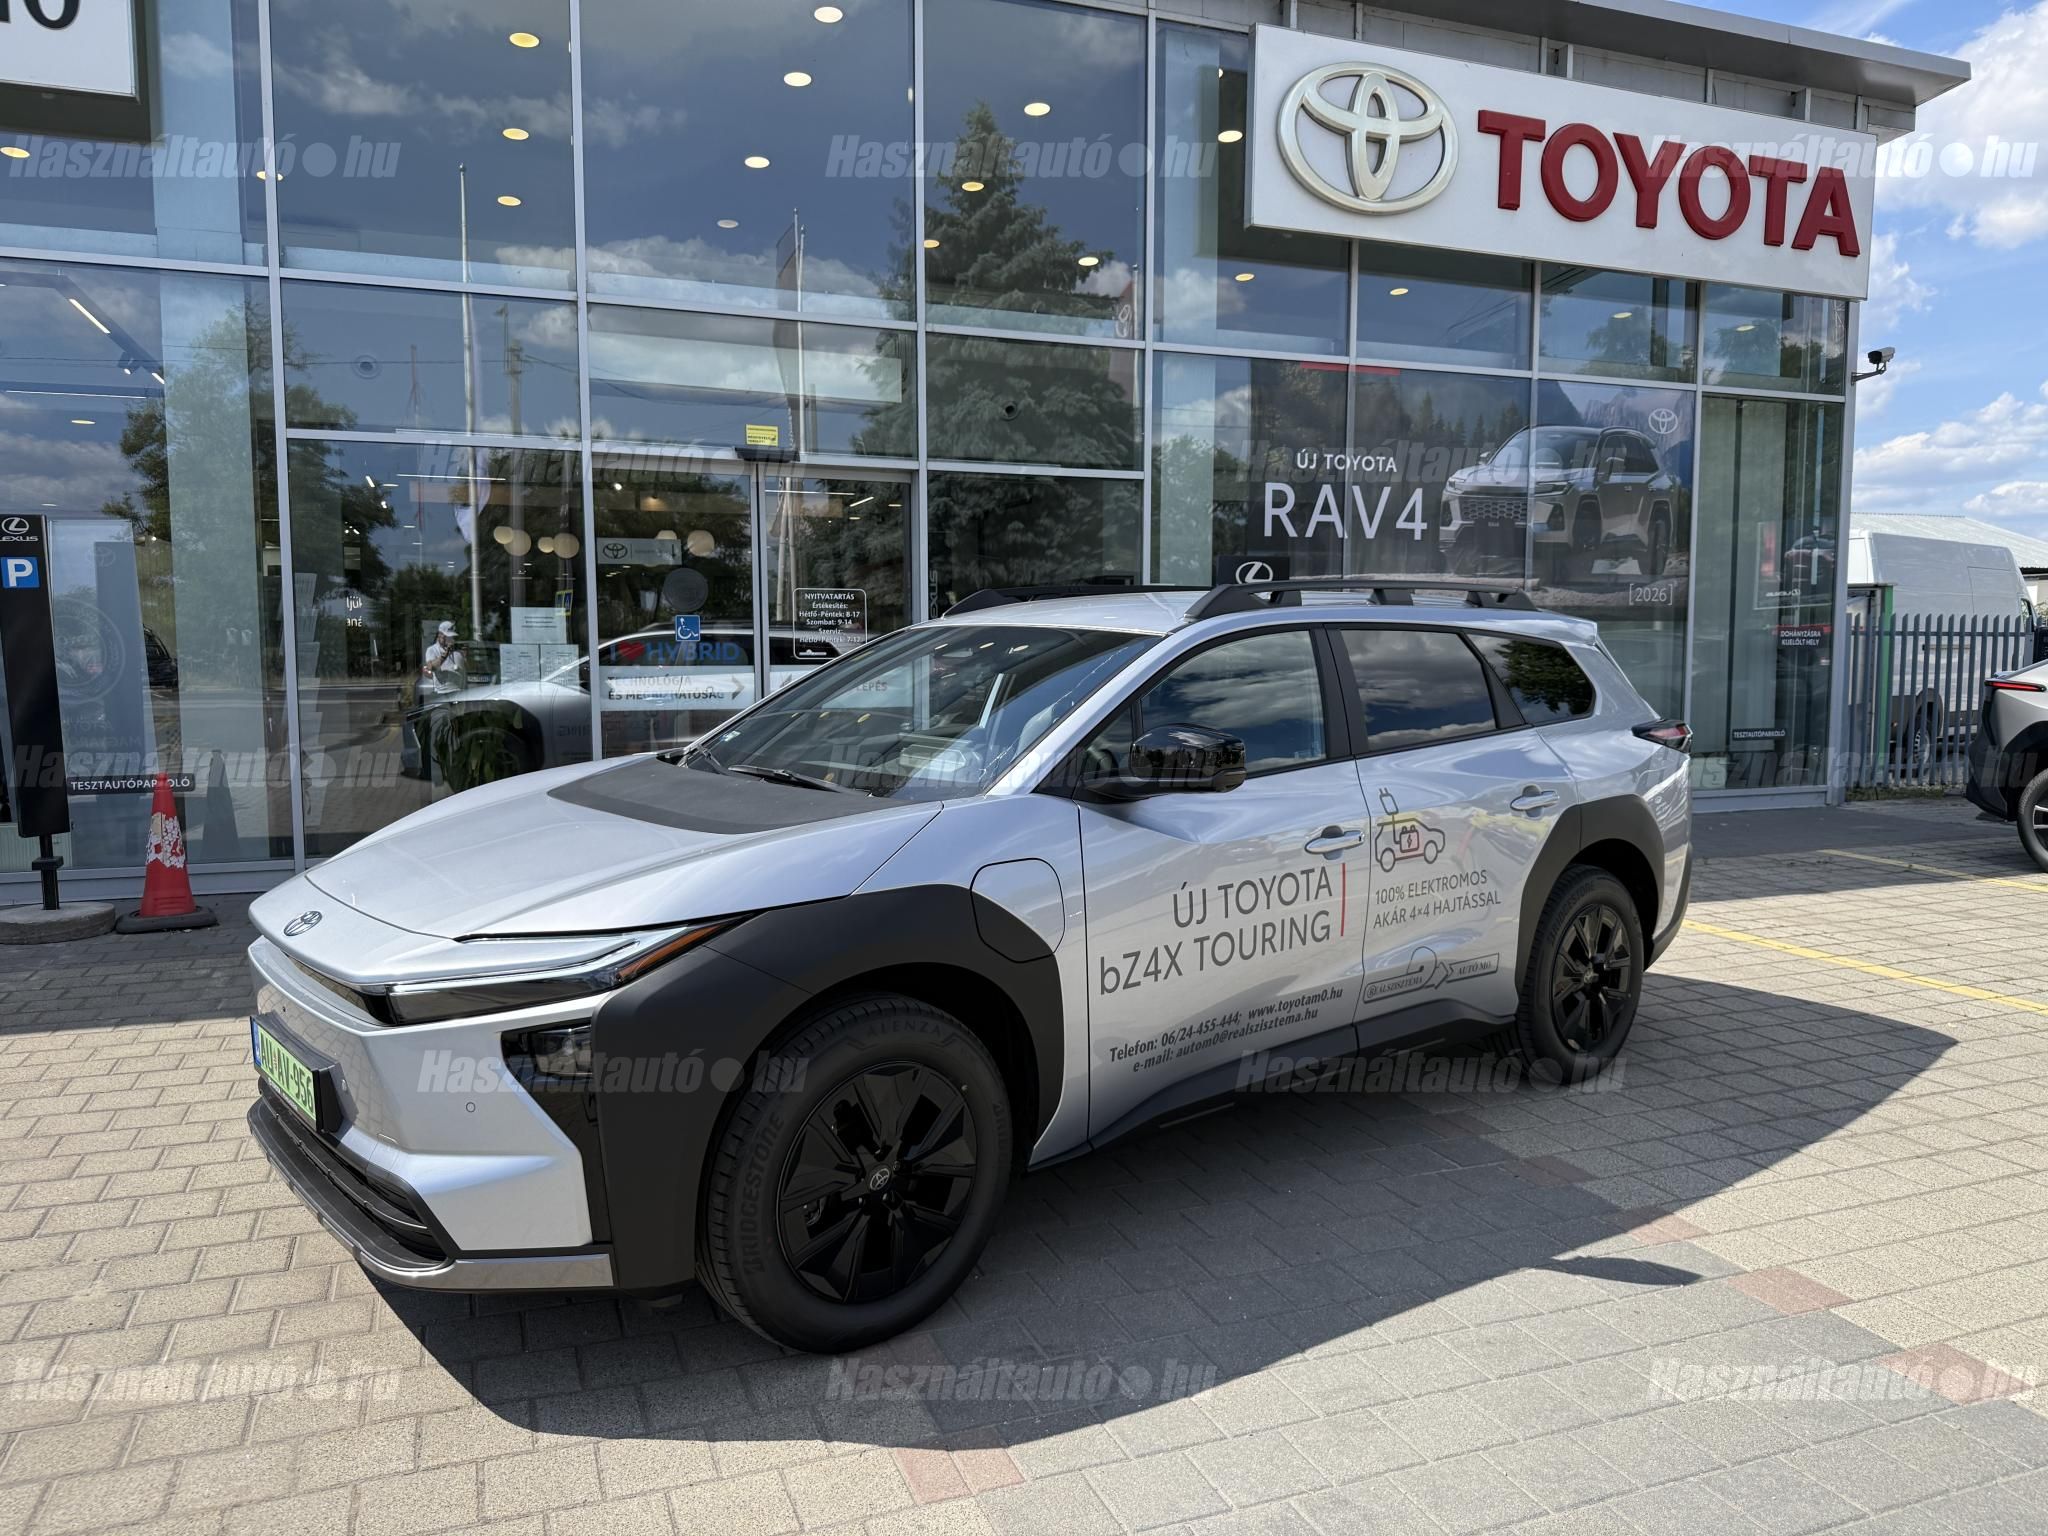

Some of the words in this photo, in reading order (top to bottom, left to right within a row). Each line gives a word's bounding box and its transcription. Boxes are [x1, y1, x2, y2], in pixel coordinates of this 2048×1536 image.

[1478, 110, 1860, 257] TOYOTA
[1296, 448, 1317, 470] ÚJ
[1323, 454, 1398, 473] TOYOTA
[1263, 482, 1428, 541] RAV4
[7, 558, 33, 587] P
[804, 592, 855, 601] NYITVATARTÁS
[806, 618, 837, 626] Szombat:
[646, 641, 740, 662] HYBRID
[1805, 638, 1820, 646] HELY
[71, 776, 190, 790] TESZTAUTÓPAROLÓ
[1173, 882, 1207, 928] ÚJ
[1218, 866, 1333, 919] TOYOTA
[1375, 886, 1405, 905] 100%
[1408, 869, 1487, 898] ELEKTROMOS
[1373, 904, 1407, 929] AKÁR
[1433, 890, 1502, 917] HAJTÁSSAL
[1100, 941, 1183, 995] bZ4X
[1194, 910, 1330, 971] TOURING
[1110, 1036, 1158, 1063] Telefon:
[1161, 1011, 1242, 1048] 06/24-455-444;
[1248, 987, 1344, 1021] www.toyotam0.hu
[1133, 1049, 1174, 1073] e-mail:
[1176, 1008, 1319, 1059] autom0@realszisztema.hu
